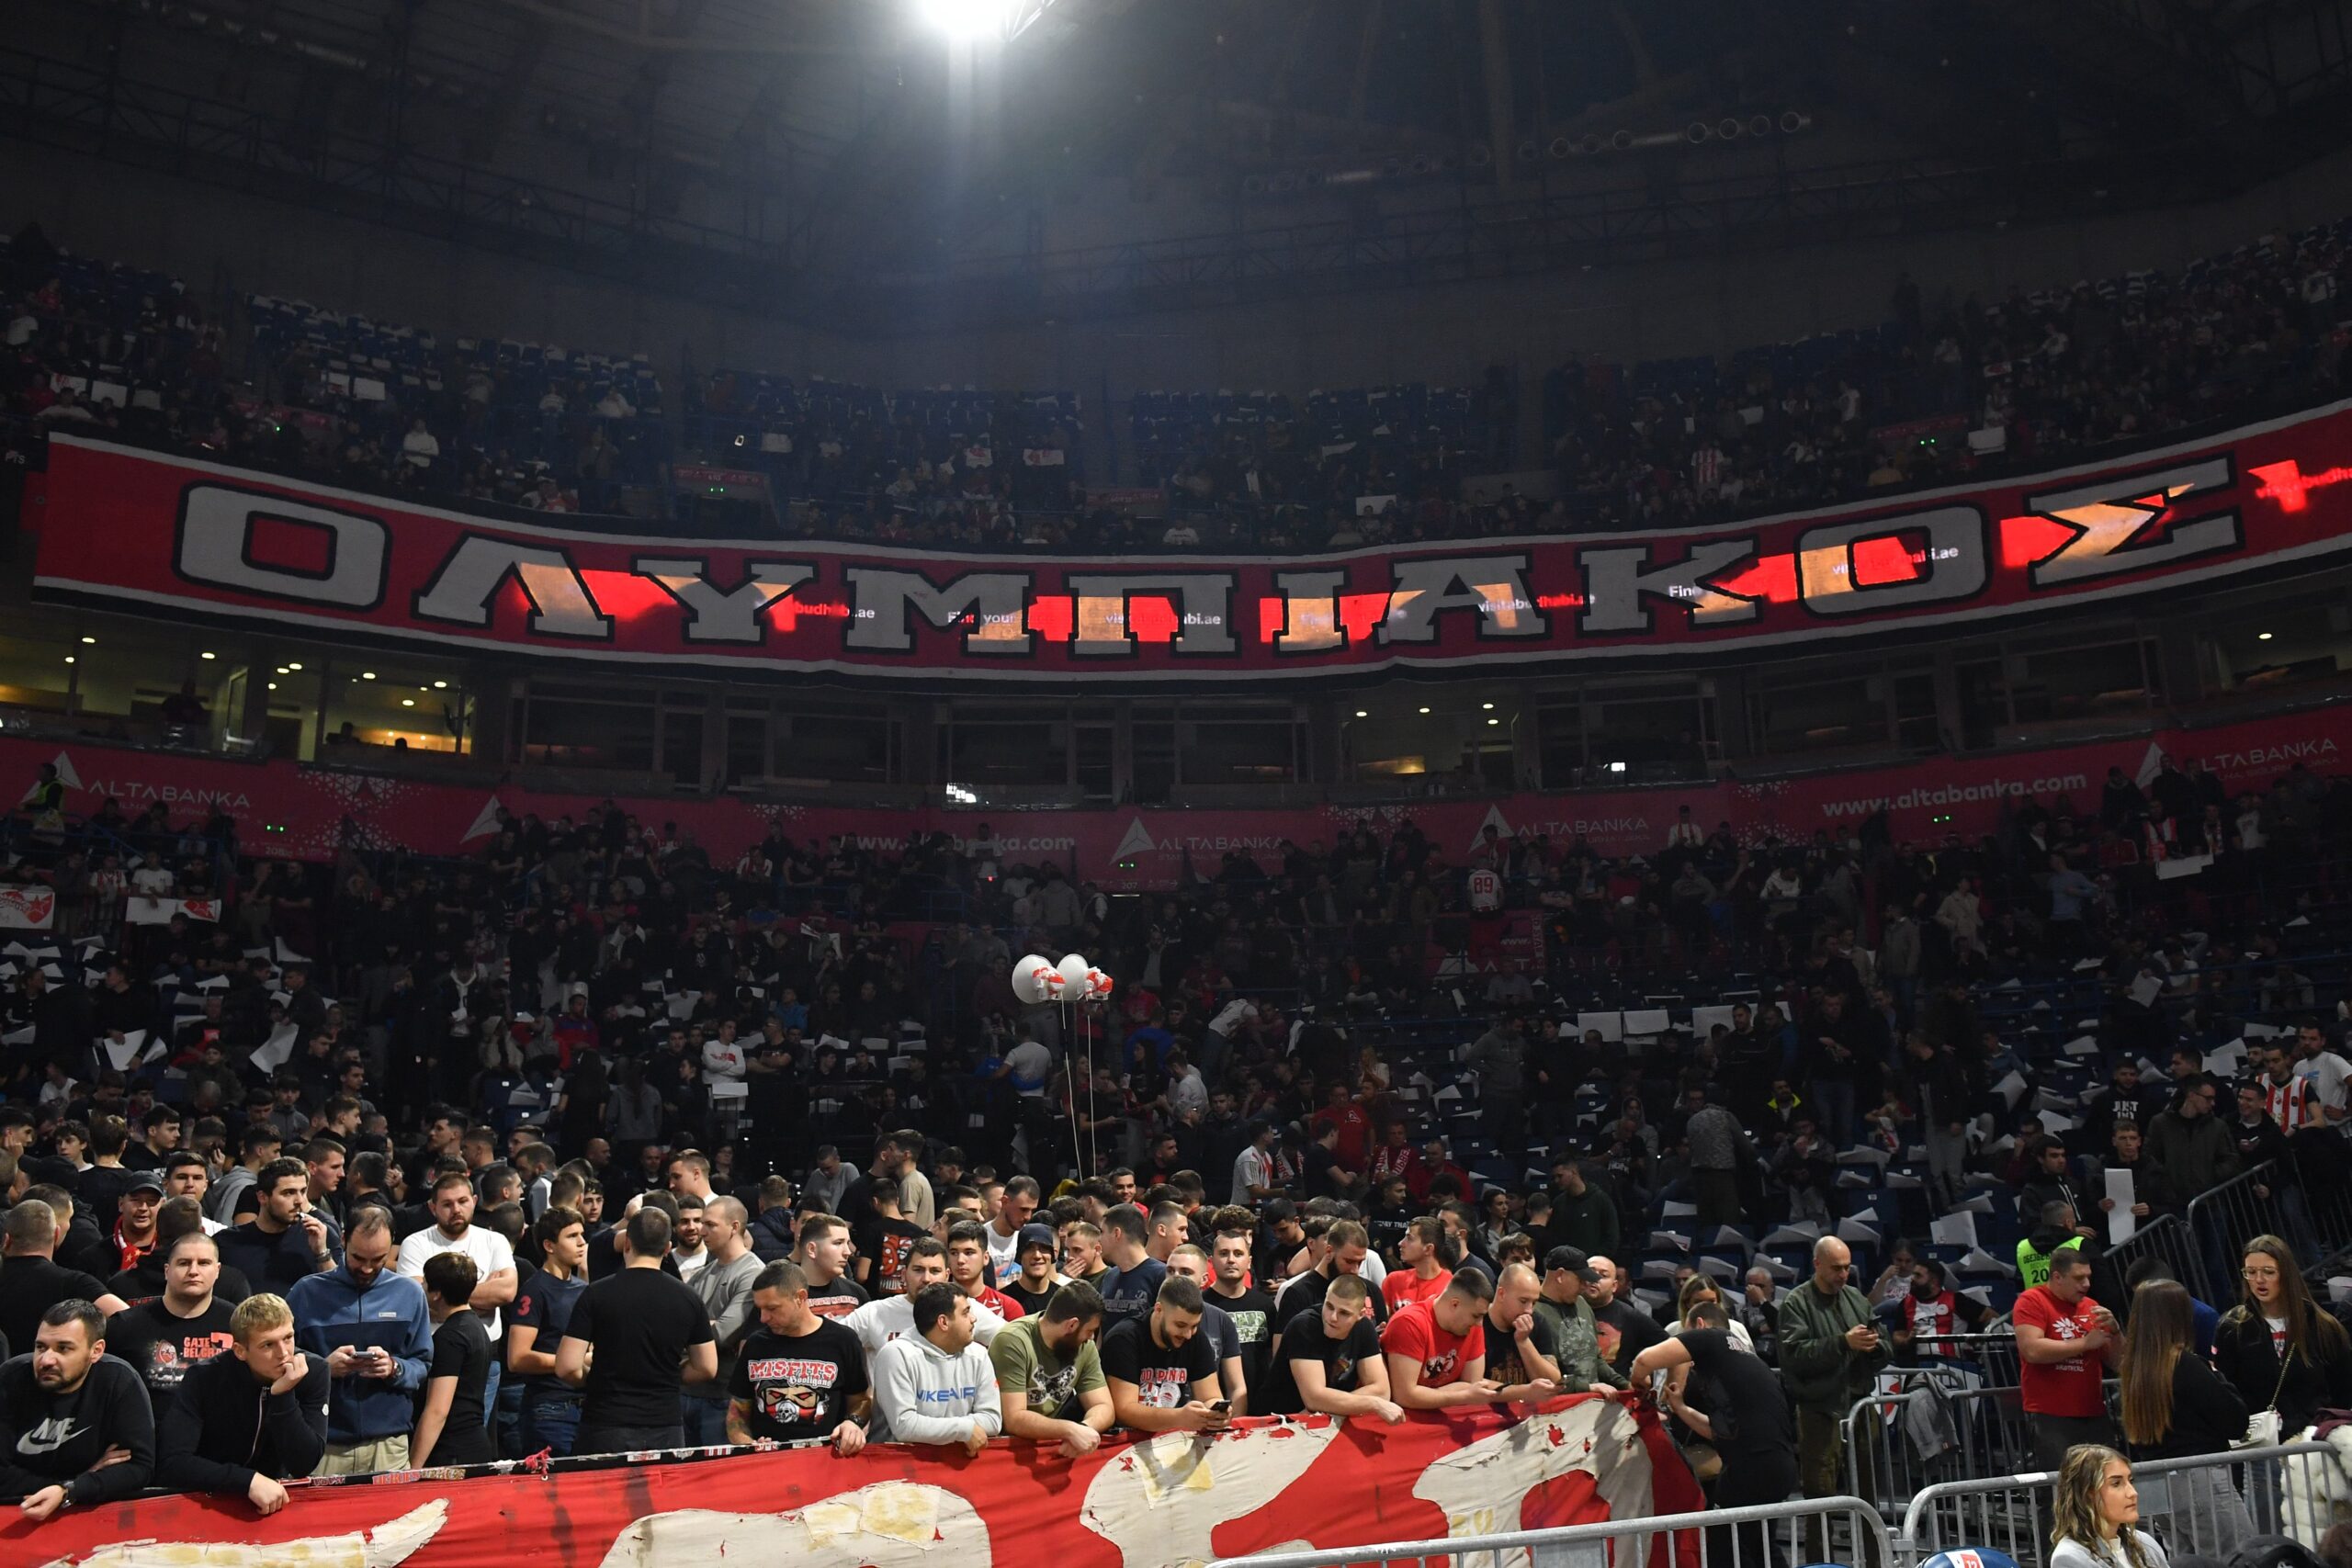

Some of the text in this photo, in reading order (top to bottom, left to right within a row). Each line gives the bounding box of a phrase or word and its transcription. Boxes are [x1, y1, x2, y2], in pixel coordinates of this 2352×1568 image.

[2201, 738, 2337, 773] LTABANKA
[88, 781, 250, 807] ALTABANKA
[1823, 774, 2087, 818] www.altabanka.com
[1520, 818, 1649, 837] ALTABANKA
[1474, 876, 1494, 894] 89
[517, 1295, 531, 1315] 3
[184, 1337, 210, 1348] GATE
[750, 1359, 837, 1381] MISFITS
[31, 1417, 76, 1442] NIKE
